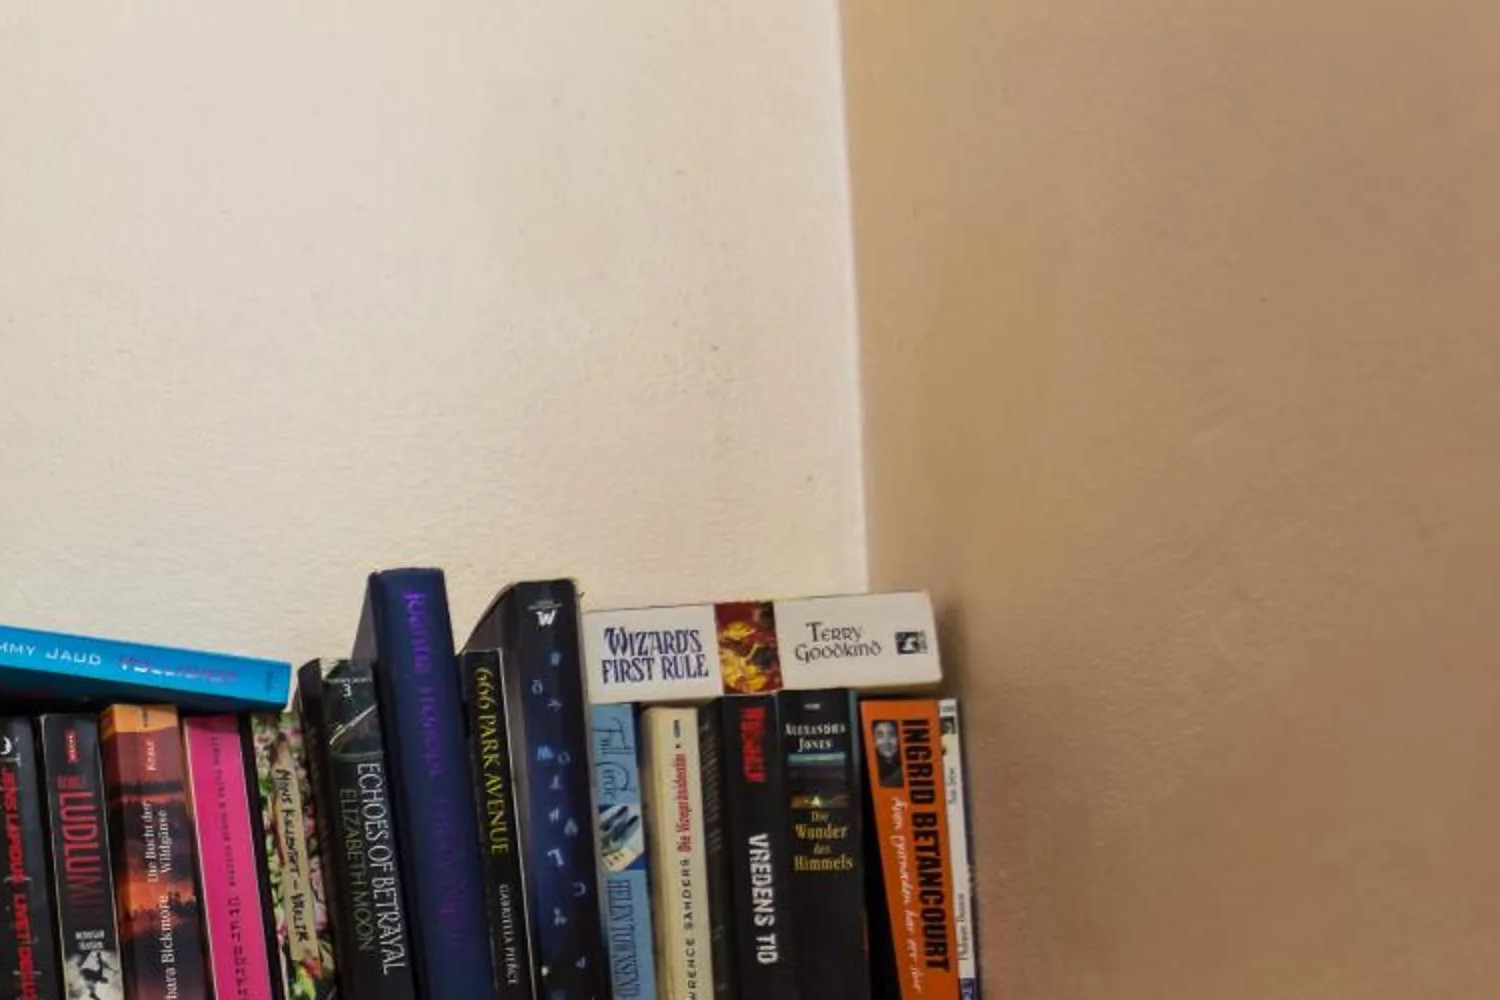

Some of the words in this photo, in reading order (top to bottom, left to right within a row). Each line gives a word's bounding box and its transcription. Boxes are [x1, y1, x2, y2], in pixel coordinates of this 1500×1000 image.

[45, 646, 102, 666] JAUD
[601, 659, 654, 683] FIRST
[661, 654, 709, 679] RULE
[475, 667, 494, 710] 666
[478, 715, 501, 768] PARK
[798, 738, 832, 752] JONES
[902, 720, 935, 804] INGRID
[358, 763, 389, 841] ECHOES
[483, 772, 510, 854] AVENUE
[796, 824, 848, 839] Wunder
[59, 791, 103, 906] LUDLUM
[340, 788, 369, 887] ELIZABETH
[368, 845, 394, 872] OF
[794, 854, 853, 871] Himmels
[679, 859, 695, 931] SANDERS
[748, 833, 775, 927] VREDENS
[912, 812, 949, 973] BETANCOURT
[159, 896, 175, 963] Bickmore
[352, 891, 375, 951] MOON
[371, 877, 405, 975] BETRAYAL
[756, 932, 779, 965] TID
